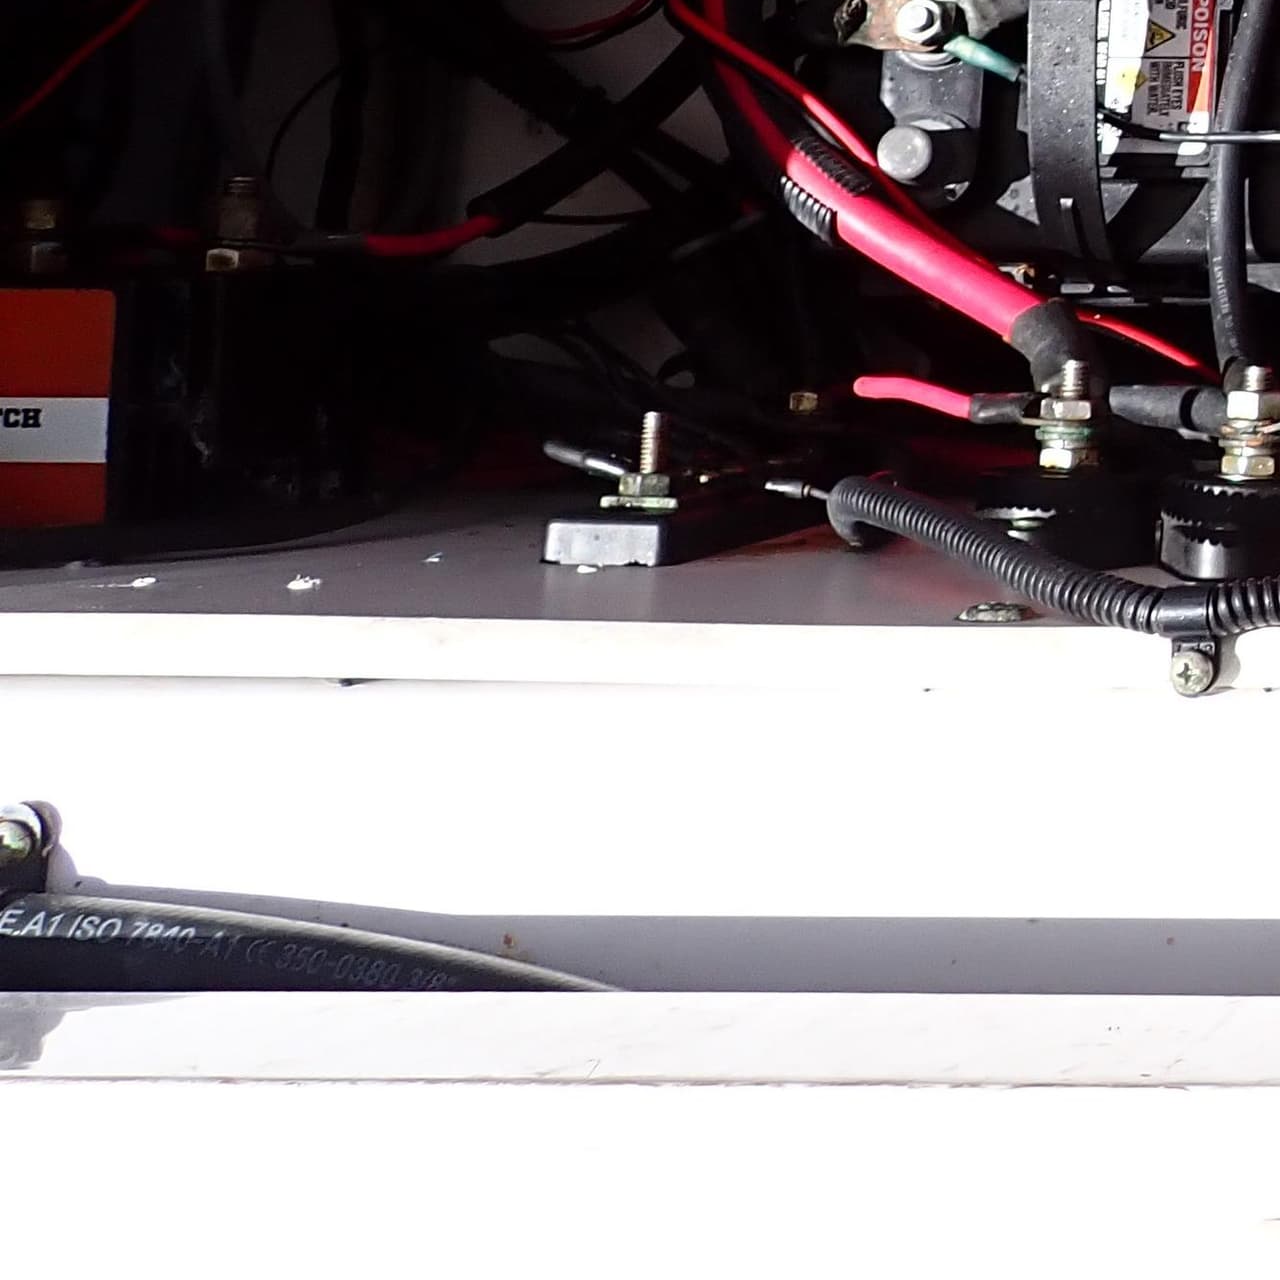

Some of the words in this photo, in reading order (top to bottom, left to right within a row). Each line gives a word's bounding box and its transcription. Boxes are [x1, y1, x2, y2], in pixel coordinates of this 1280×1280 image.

[1149, 62, 1160, 84] WITH
[1172, 62, 1185, 84] FLUSH
[1159, 62, 1172, 118] IMMEDIATELY
[1171, 87, 1183, 111] EYES
[64, 917, 125, 942] ISO
